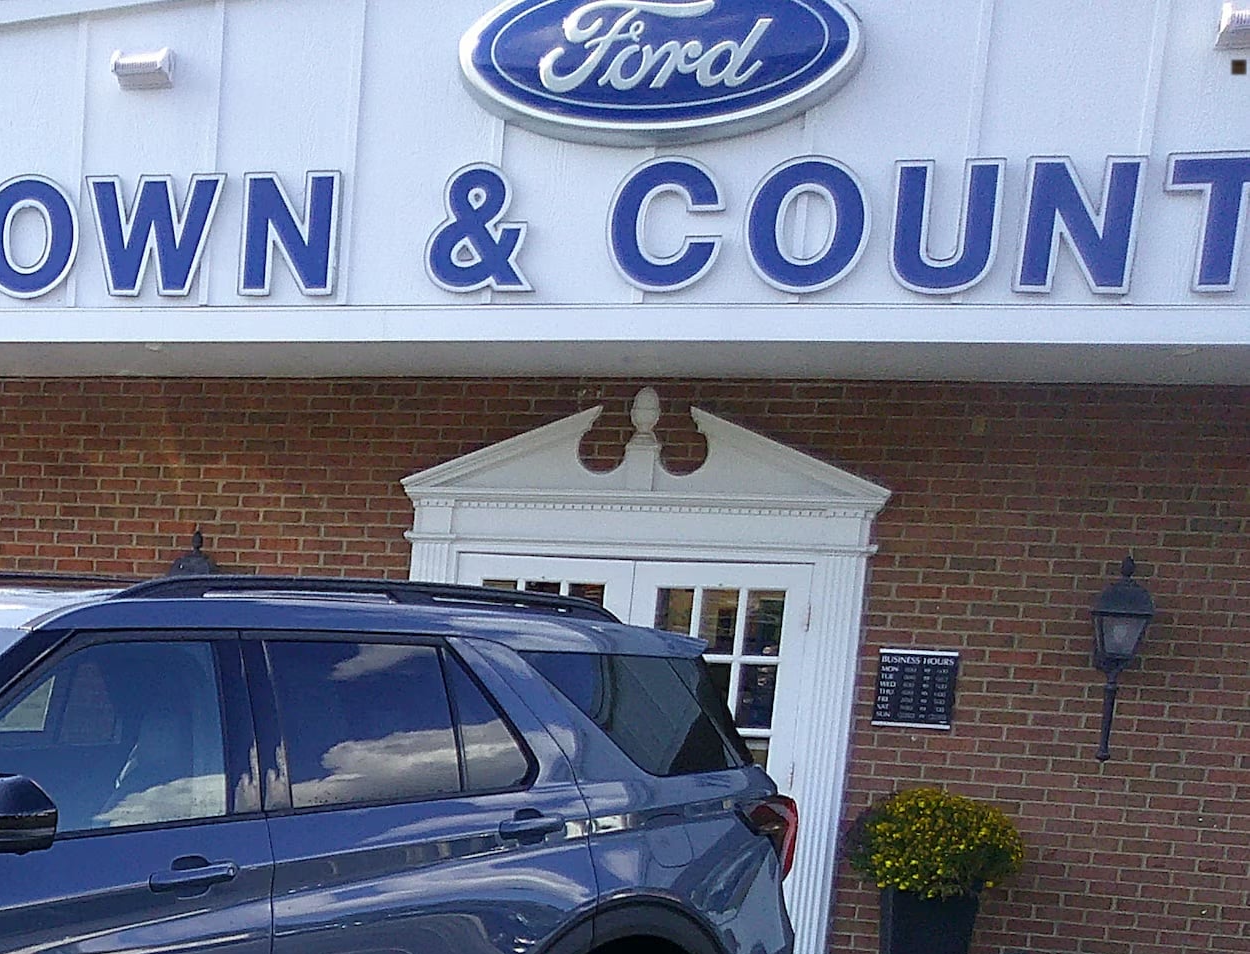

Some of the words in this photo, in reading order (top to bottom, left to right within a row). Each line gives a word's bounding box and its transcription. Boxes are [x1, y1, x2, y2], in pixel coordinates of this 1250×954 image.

[539, 0, 773, 93] Ford
[424, 161, 534, 293] &
[606, 151, 1250, 295] COUNT
[881, 655, 920, 665] BUSINESS
[923, 657, 955, 666] HOURS
